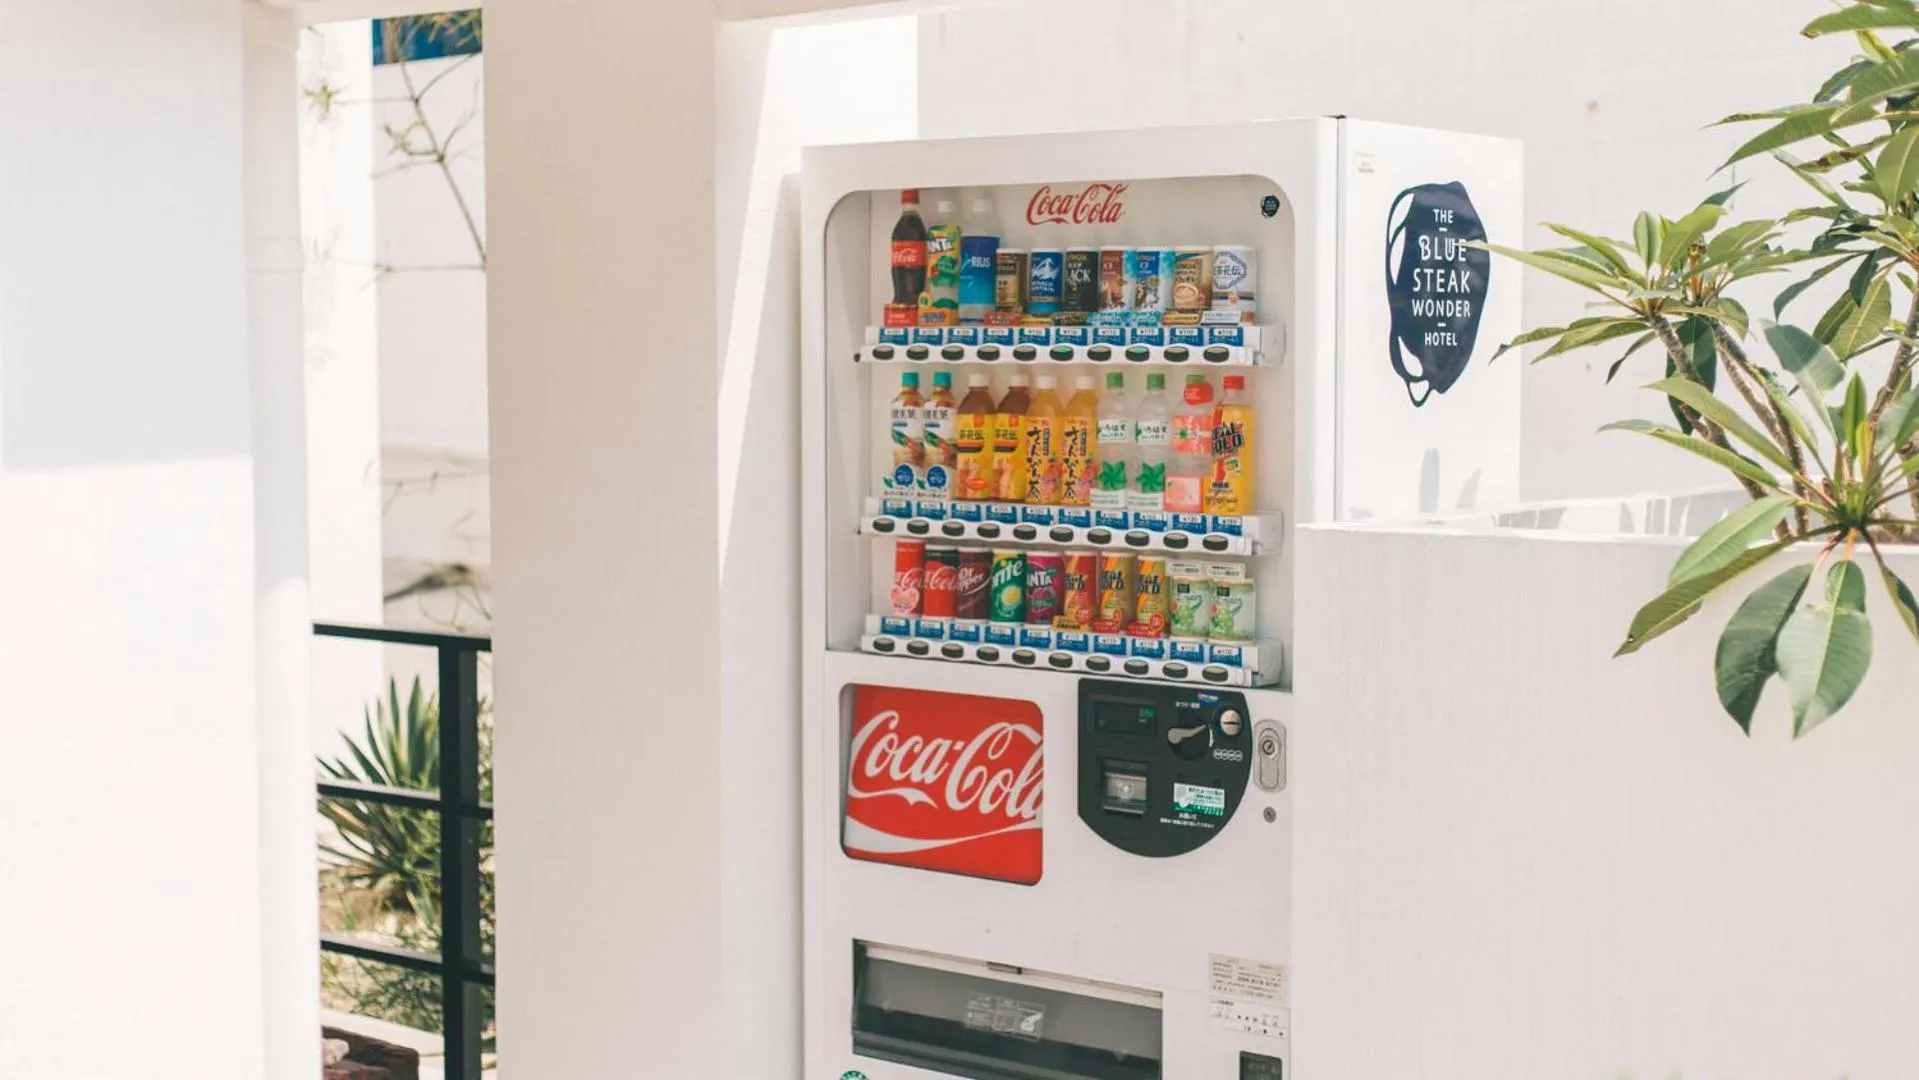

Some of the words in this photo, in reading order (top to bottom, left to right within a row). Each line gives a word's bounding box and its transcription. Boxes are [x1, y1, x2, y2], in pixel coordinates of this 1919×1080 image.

[1026, 184, 1128, 226] Coca-Cola
[1433, 208, 1454, 224] THE
[1418, 235, 1468, 262] BLUE
[1070, 269, 1092, 282] ACK
[1412, 268, 1471, 293] STEAK
[1411, 298, 1471, 318] WONDER
[1424, 331, 1458, 347] HOTEL
